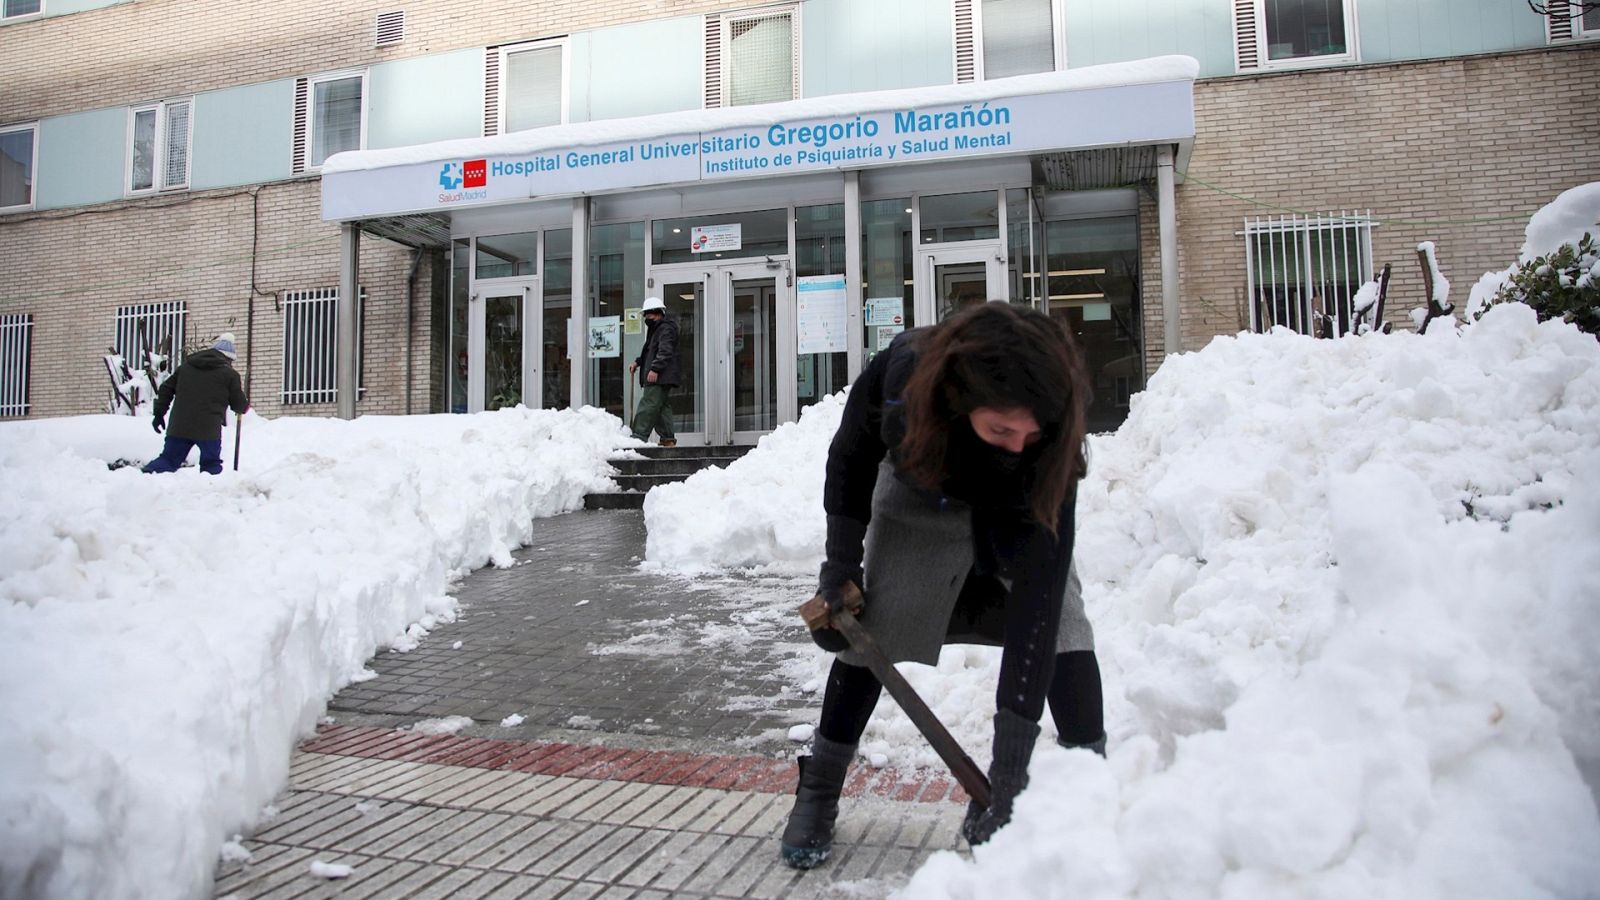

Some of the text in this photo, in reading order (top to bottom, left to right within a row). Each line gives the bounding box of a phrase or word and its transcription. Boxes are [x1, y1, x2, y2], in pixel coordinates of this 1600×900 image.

[491, 102, 1012, 177] Hospital General Universitario Gregorio Marañón
[706, 131, 1012, 173] Instituto de Psiquiatría y Salud Mental
[438, 190, 487, 203] SaludMadrid
